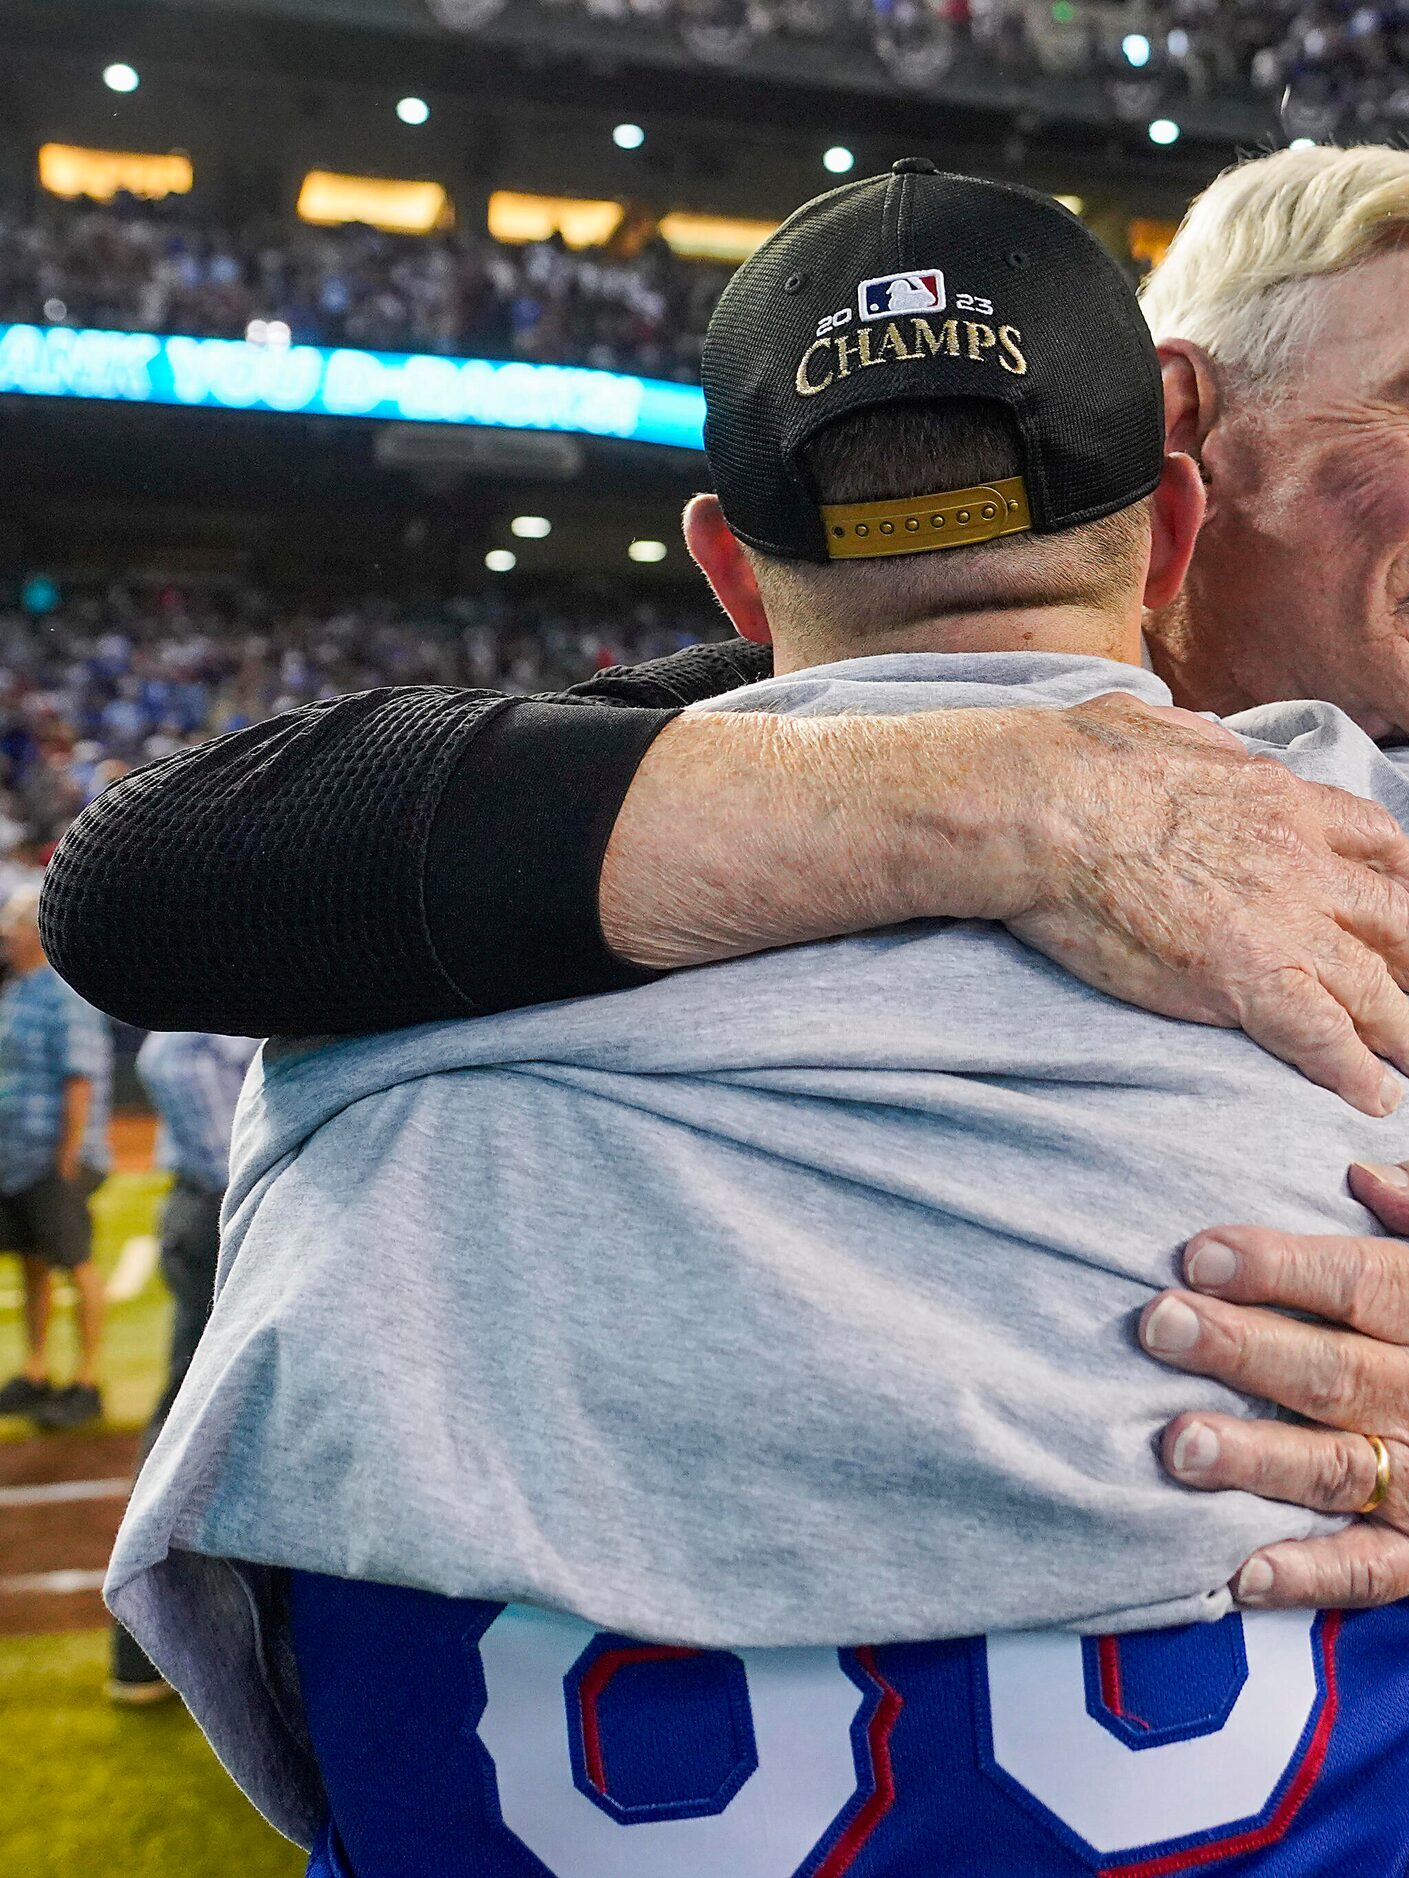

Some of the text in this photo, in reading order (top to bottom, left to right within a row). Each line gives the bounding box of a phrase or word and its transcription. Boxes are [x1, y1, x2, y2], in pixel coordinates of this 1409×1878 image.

[816, 293, 994, 337] 20 23
[795, 318, 1028, 398] CHAMPS
